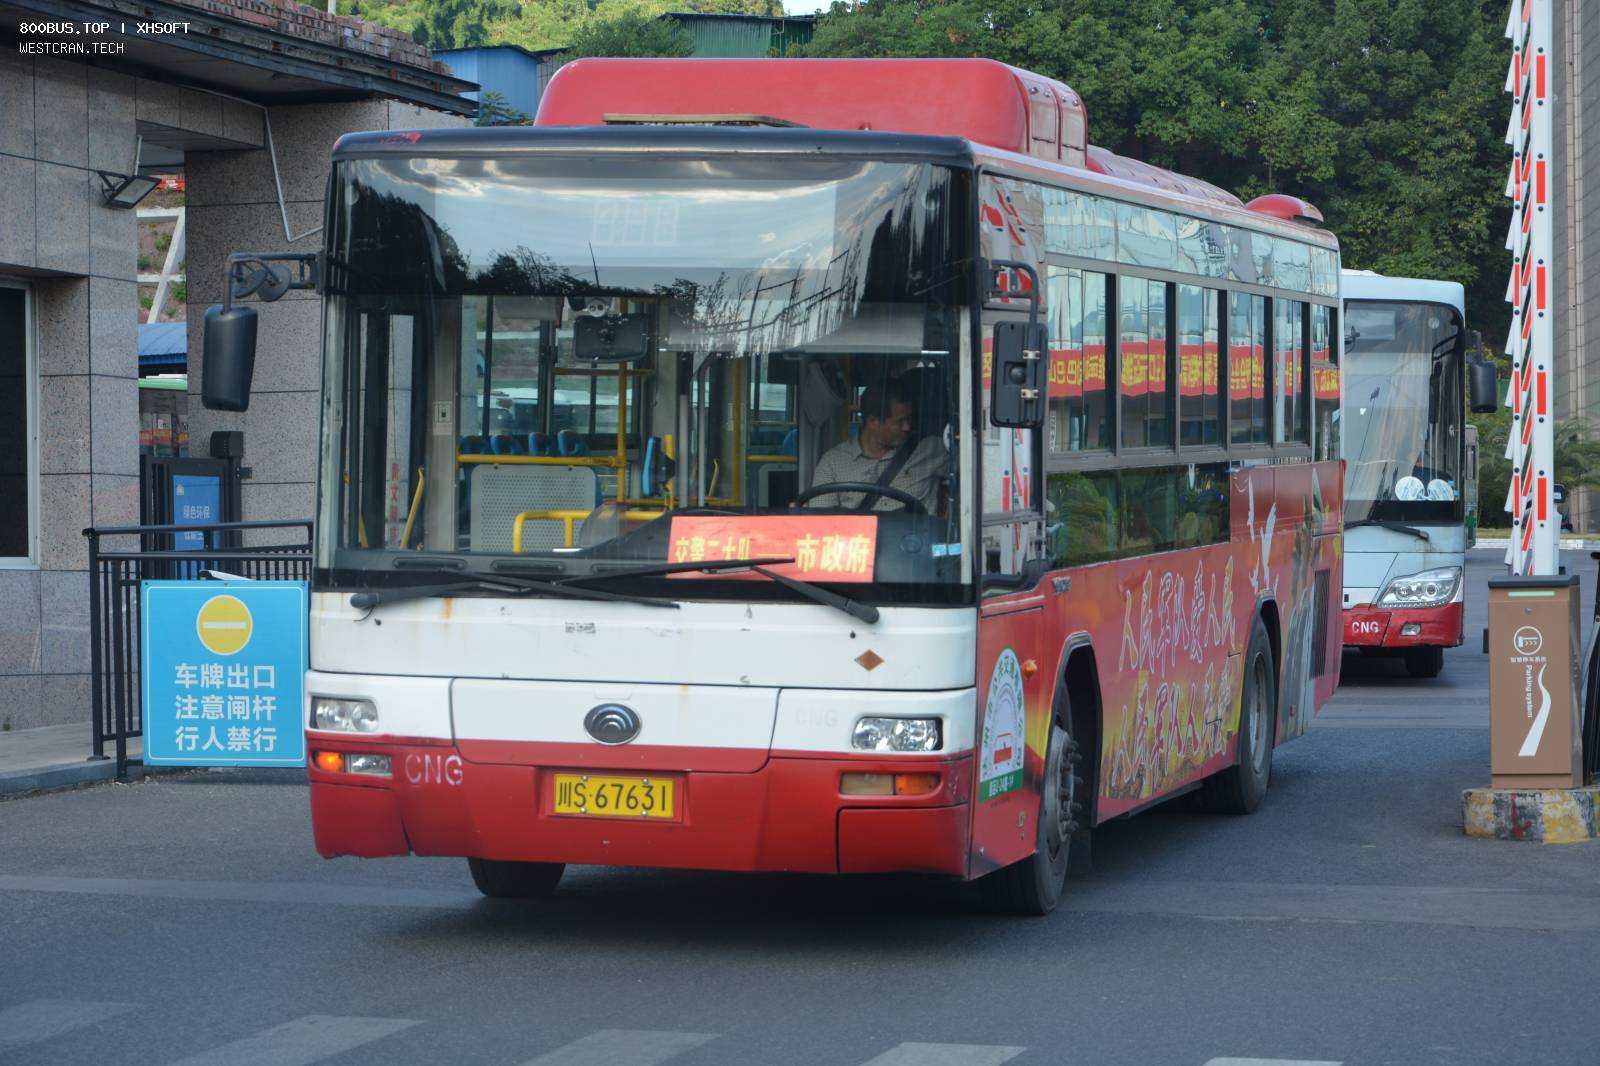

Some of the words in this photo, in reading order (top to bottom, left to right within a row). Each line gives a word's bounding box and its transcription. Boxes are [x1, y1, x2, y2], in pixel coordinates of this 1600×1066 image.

[1352, 621, 1379, 633] CNG
[174, 663, 275, 690] 车牌出口
[1525, 664, 1533, 692] Parking
[175, 694, 277, 720] 注意闸杆
[175, 726, 277, 752] 行人禁行
[404, 754, 464, 786] CNG
